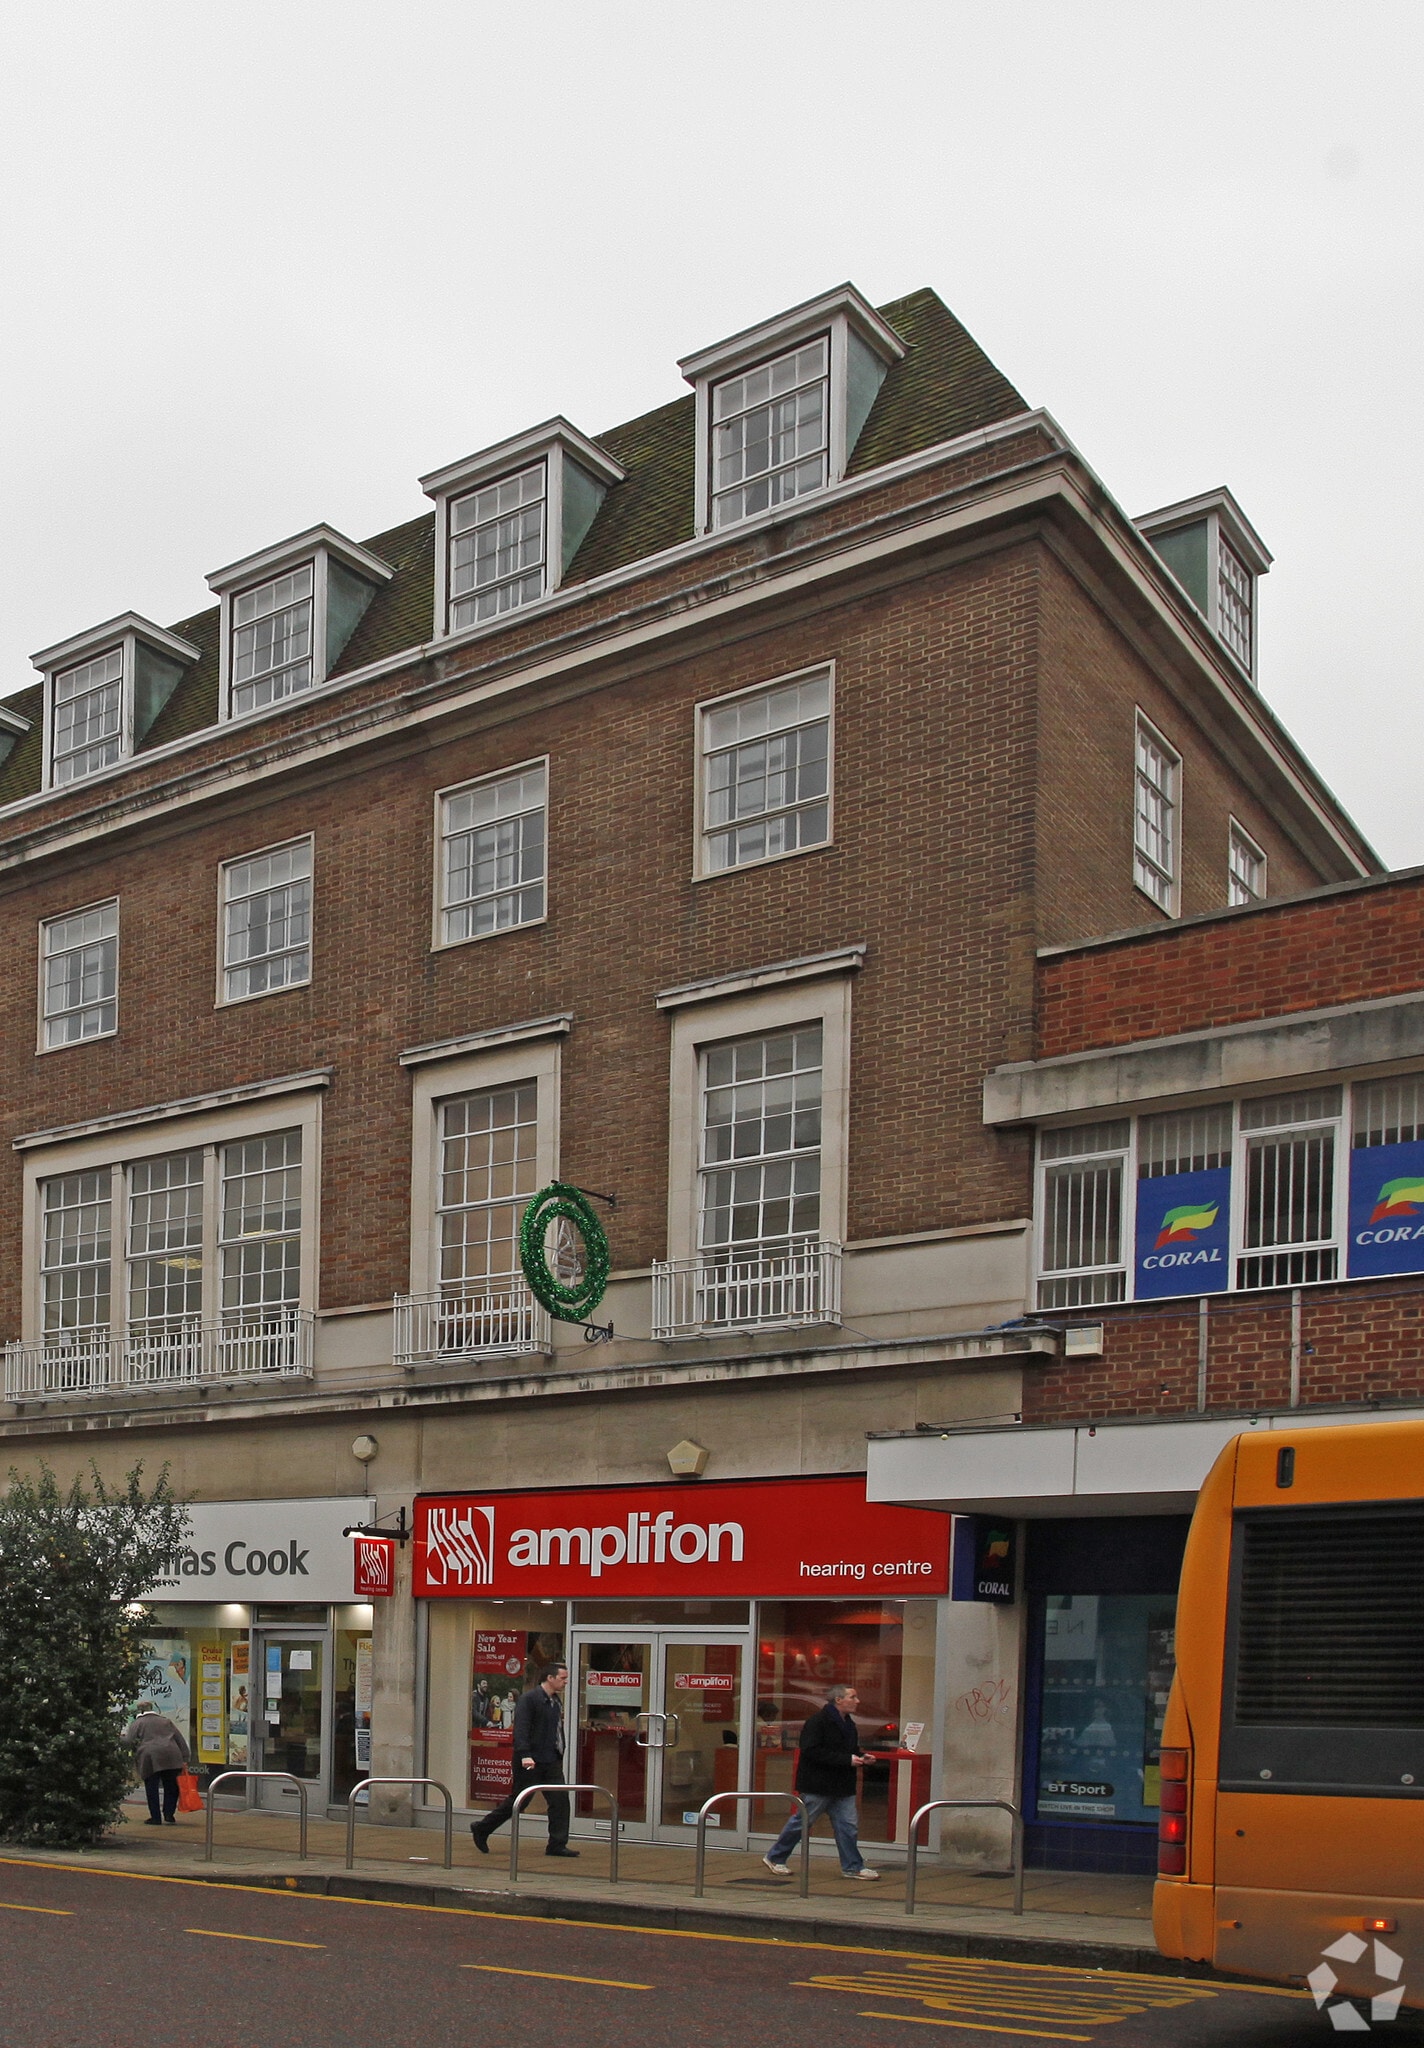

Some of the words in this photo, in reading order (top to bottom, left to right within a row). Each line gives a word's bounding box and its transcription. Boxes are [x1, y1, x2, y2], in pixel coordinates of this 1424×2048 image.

[1142, 1248, 1222, 1270] CORAL
[507, 1511, 744, 1577] amplifon
[224, 1539, 310, 1576] Cook
[799, 1560, 865, 1580] hearing
[872, 1560, 932, 1576] centre
[978, 1581, 1010, 1595] CORAL
[478, 1634, 496, 1643] New
[497, 1634, 517, 1643] Year
[201, 1646, 223, 1655] Cruise
[477, 1643, 496, 1652] Sale
[202, 1654, 221, 1662] Deals
[602, 1673, 639, 1685] amplifon
[690, 1675, 729, 1687] amplifon
[150, 1684, 172, 1697] times
[476, 1774, 513, 1785] Audiology
[1048, 1783, 1068, 1793] BT
[1070, 1784, 1106, 1796] Sport
